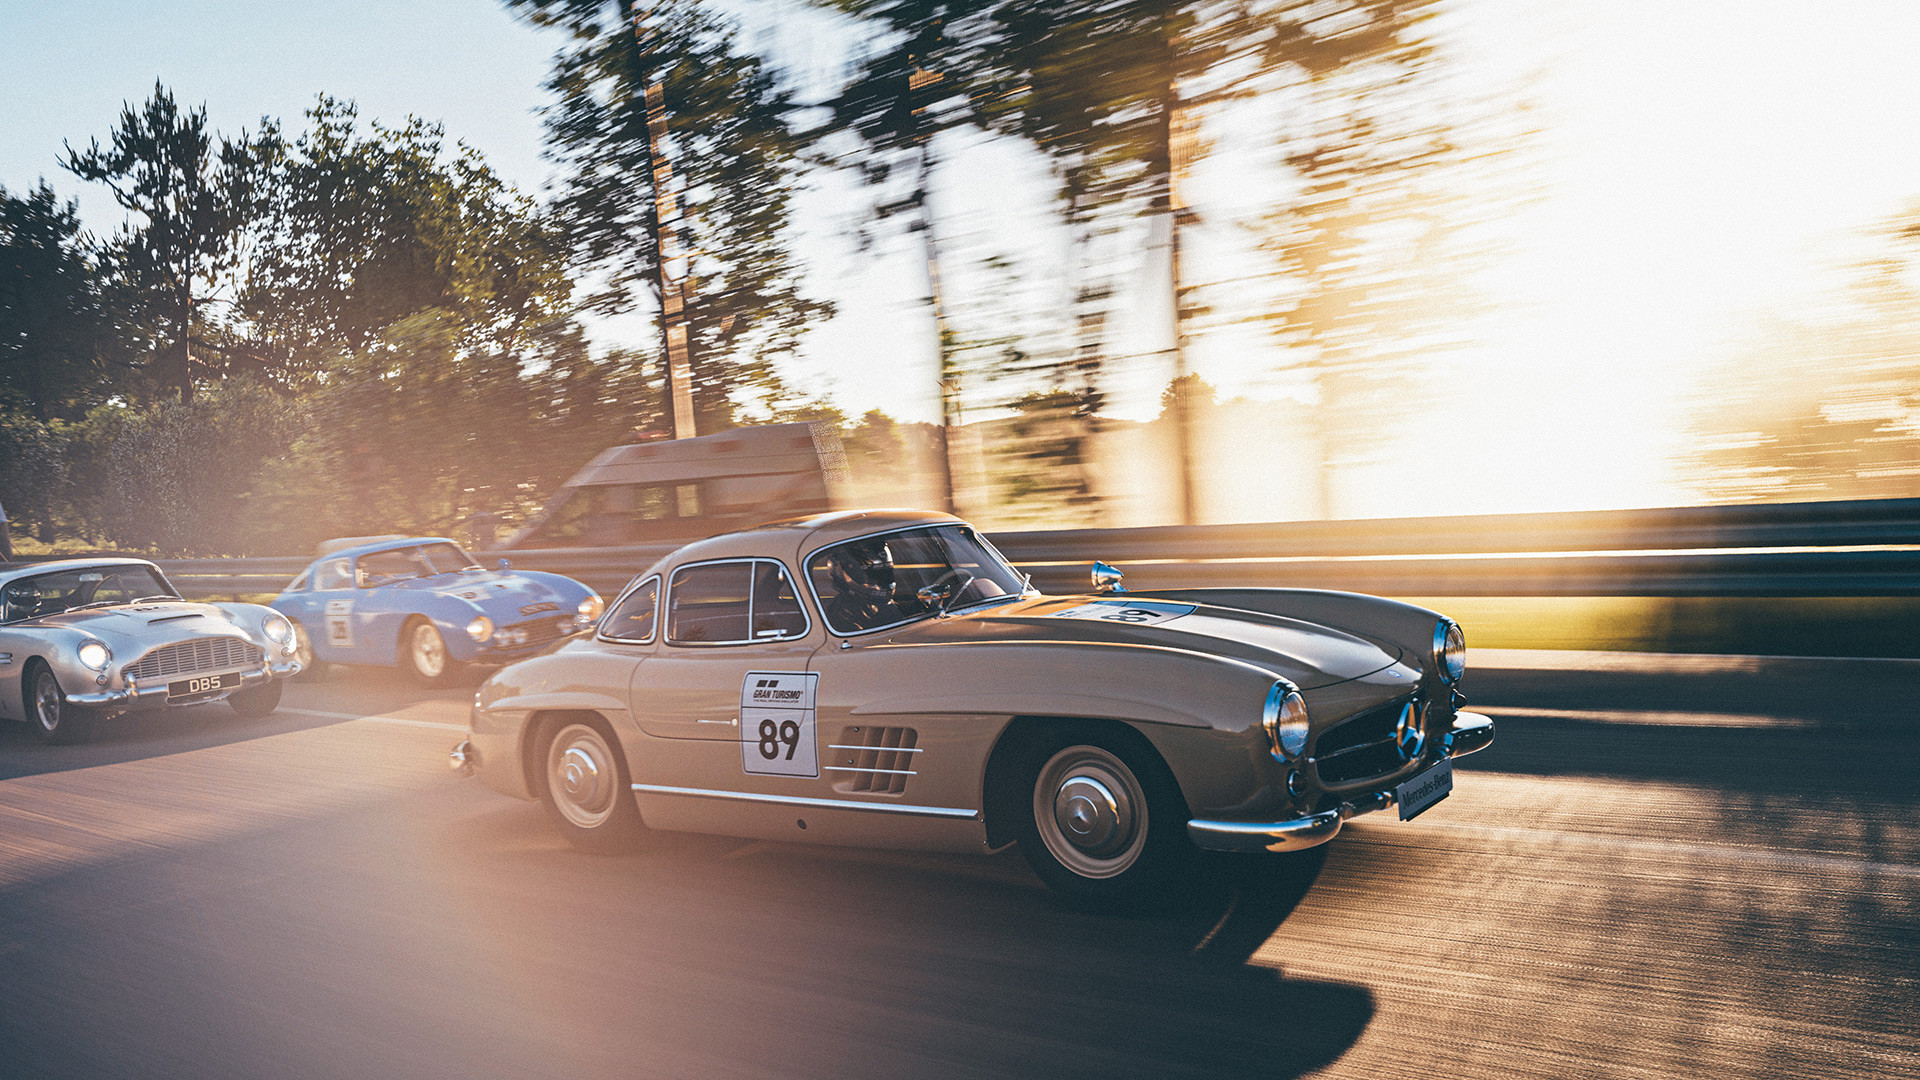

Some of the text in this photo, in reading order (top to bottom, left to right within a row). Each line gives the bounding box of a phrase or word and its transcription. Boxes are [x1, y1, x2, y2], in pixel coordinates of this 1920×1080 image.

[1101, 609, 1161, 622] 89
[189, 676, 221, 692] DB5
[753, 690, 772, 698] GRAN
[759, 719, 799, 760] 89
[1402, 771, 1450, 809] Mercedes-Benz
